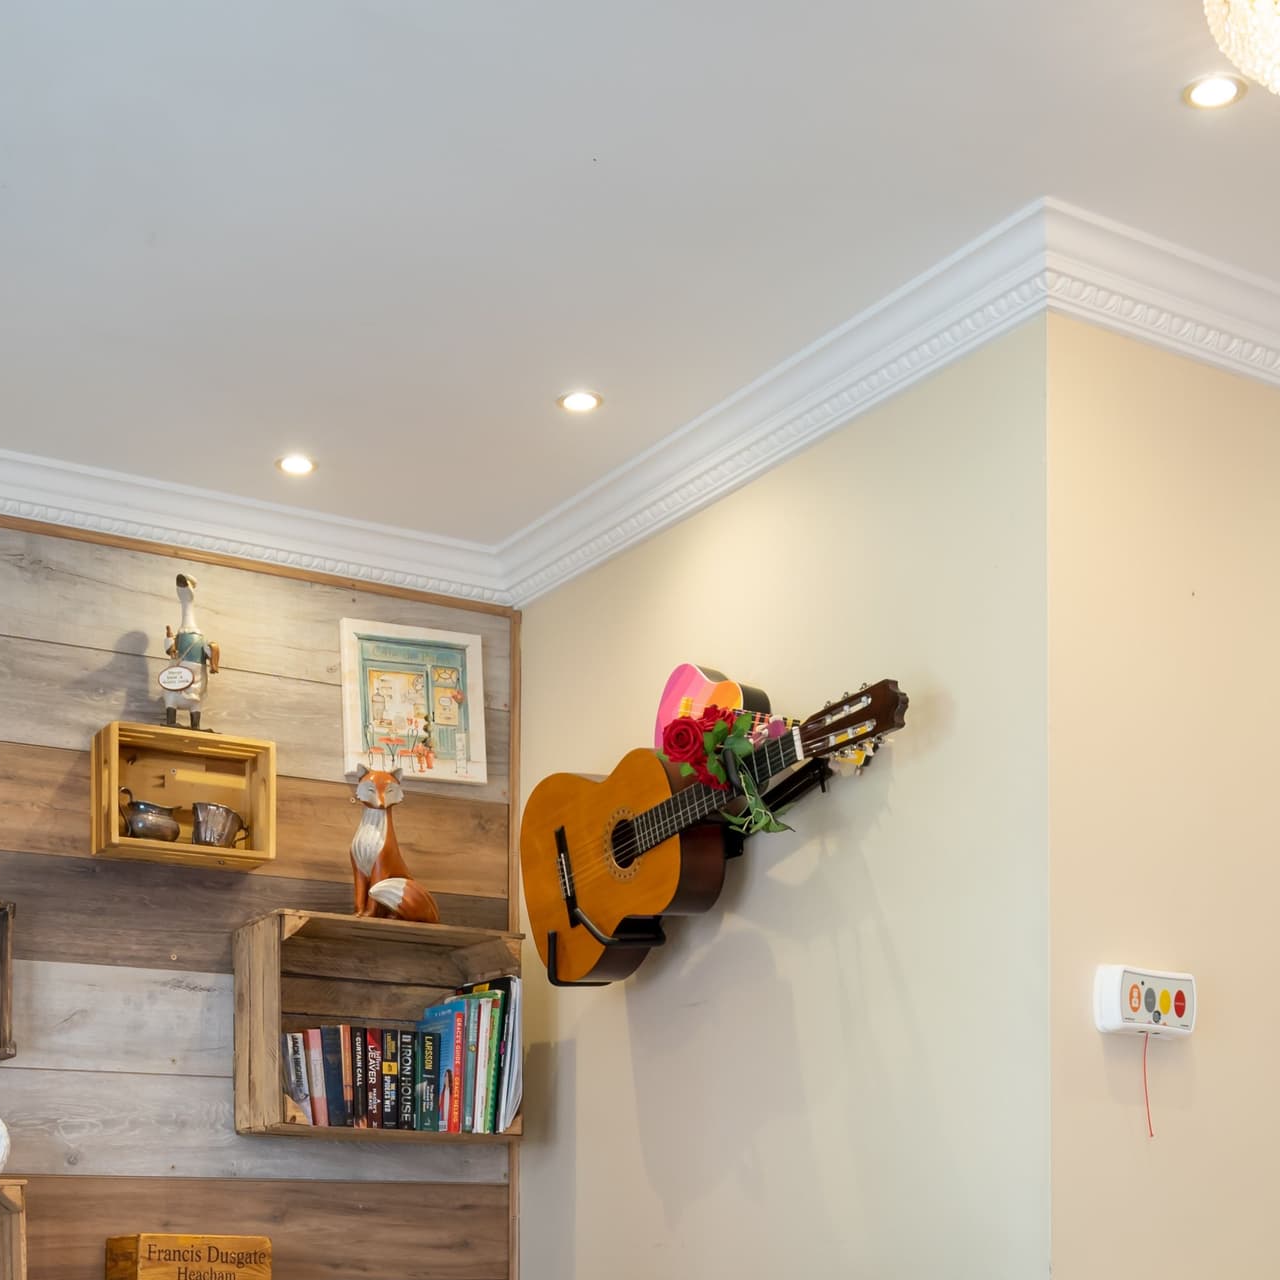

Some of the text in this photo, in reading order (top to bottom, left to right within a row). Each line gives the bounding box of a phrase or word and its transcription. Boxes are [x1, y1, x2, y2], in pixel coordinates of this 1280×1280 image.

[291, 1035, 303, 1088] JACK HIGGINS
[401, 1045, 412, 1075] IRON
[401, 1077, 411, 1121] HOUSE
[147, 1243, 266, 1268] Francis Dusgate
